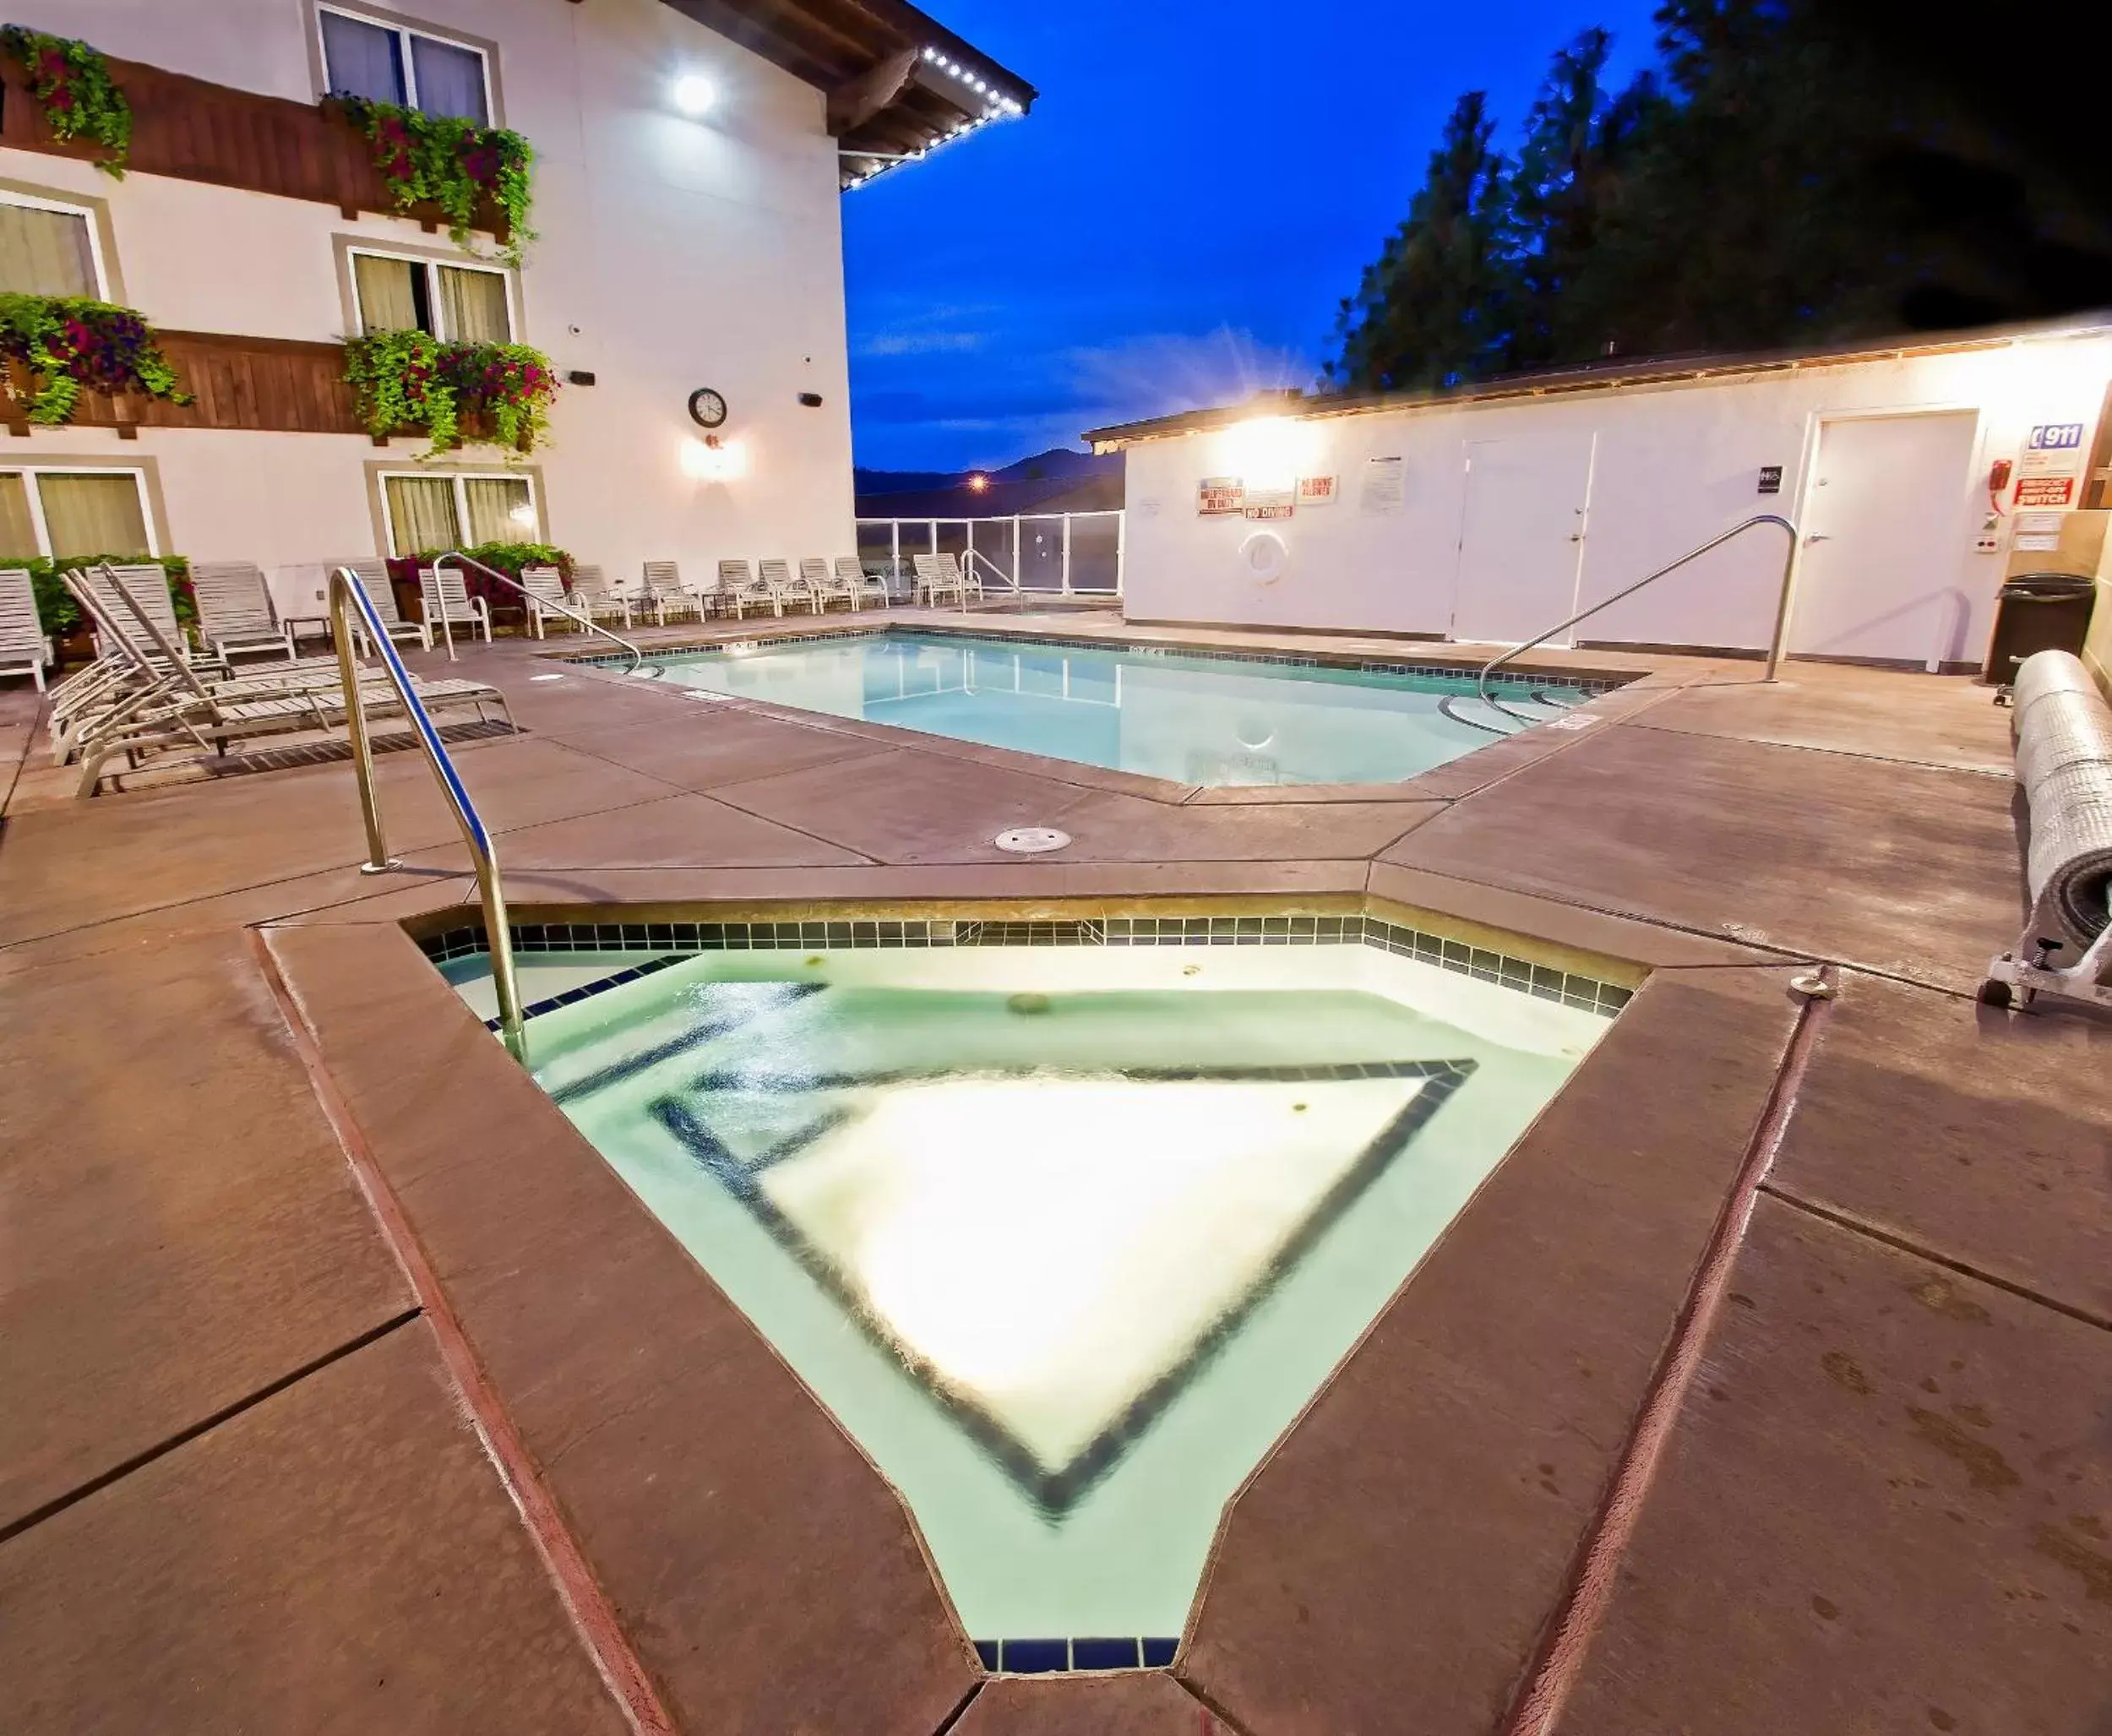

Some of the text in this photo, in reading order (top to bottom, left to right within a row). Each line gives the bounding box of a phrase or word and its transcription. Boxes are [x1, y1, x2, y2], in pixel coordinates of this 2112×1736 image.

[2045, 425, 2081, 447] 911
[2018, 494, 2066, 505] SWITCH
[1246, 507, 1291, 518] NO DIVING
